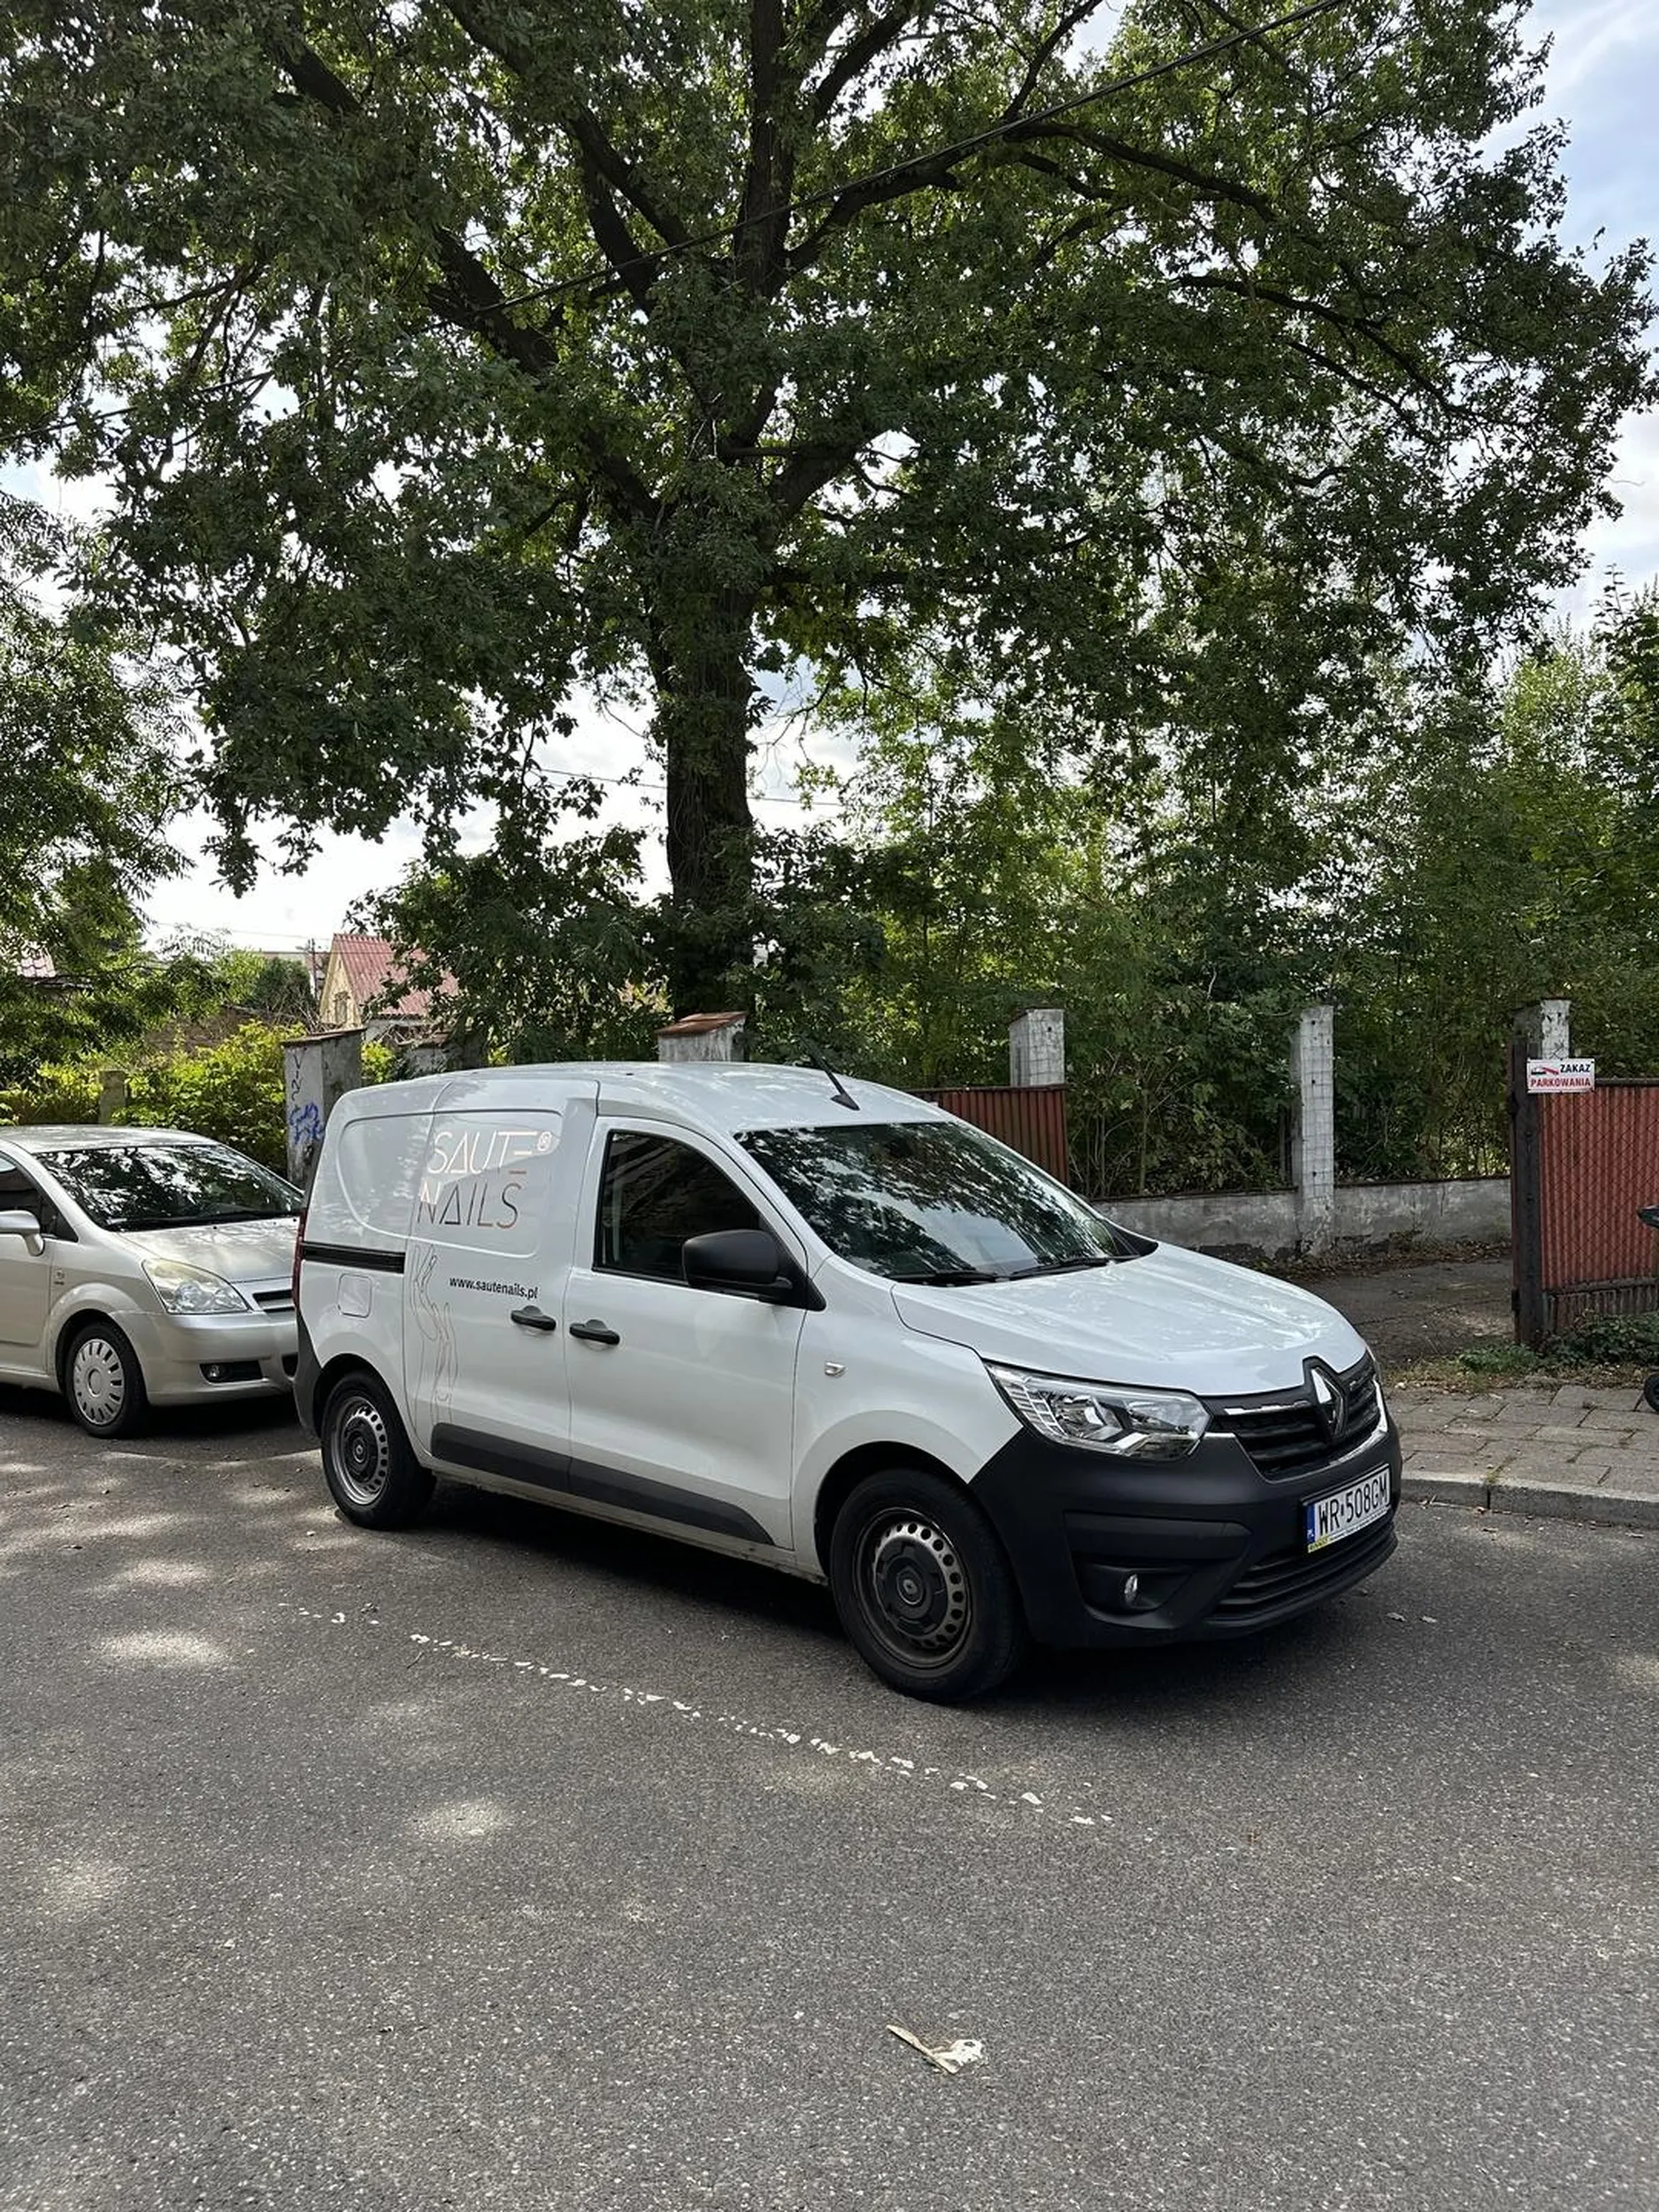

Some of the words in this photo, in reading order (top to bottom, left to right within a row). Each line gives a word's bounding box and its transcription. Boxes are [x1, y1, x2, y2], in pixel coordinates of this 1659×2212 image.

[1531, 1078, 1591, 1087] PARKOWANIA
[1560, 1064, 1590, 1073] ZAKAZ
[427, 1131, 538, 1175] SAUTE
[418, 1180, 522, 1229] NAILS
[449, 1278, 539, 1300] www.sautenails.pl
[1318, 1498, 1340, 1536] WR
